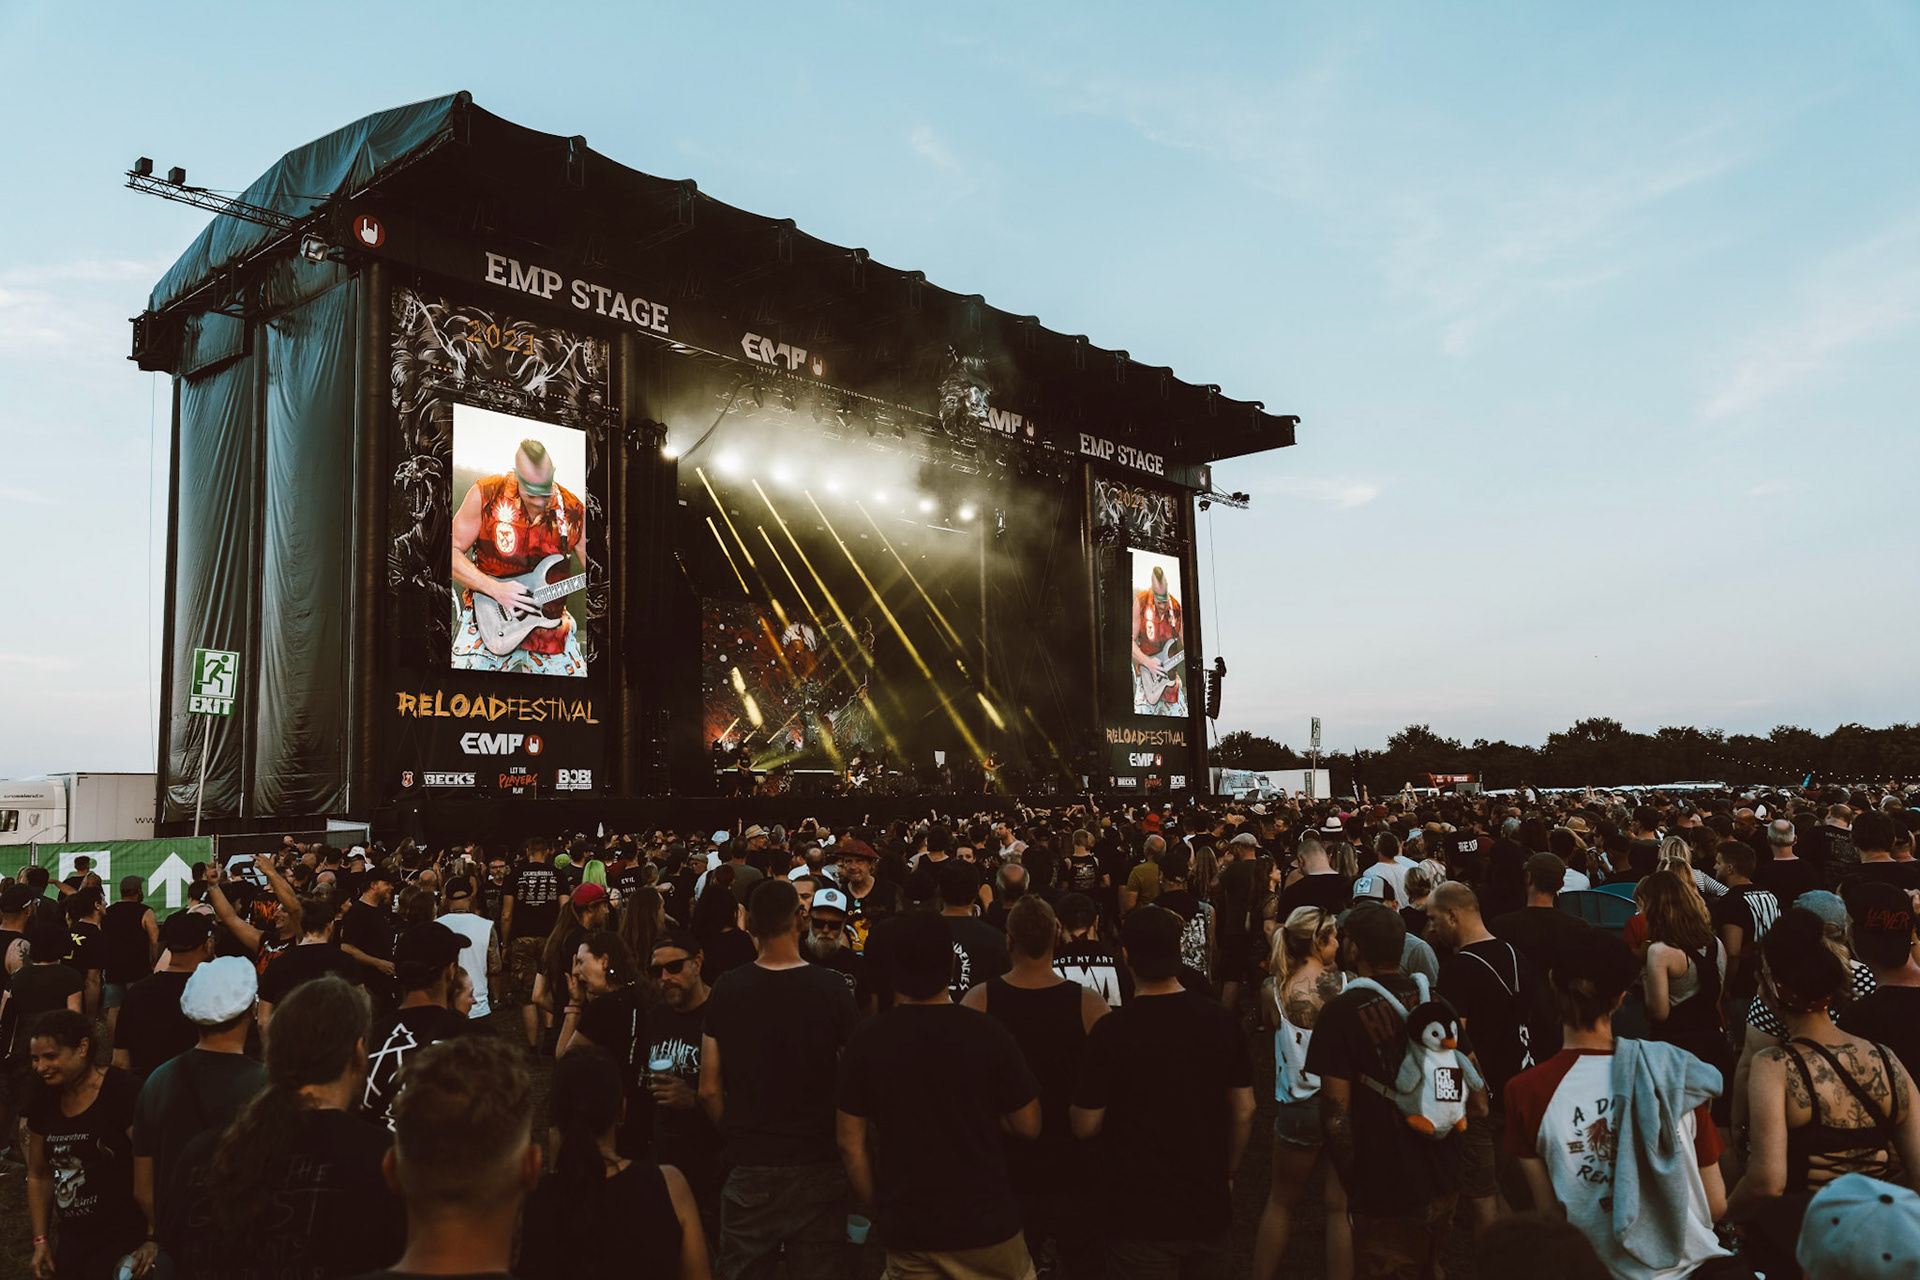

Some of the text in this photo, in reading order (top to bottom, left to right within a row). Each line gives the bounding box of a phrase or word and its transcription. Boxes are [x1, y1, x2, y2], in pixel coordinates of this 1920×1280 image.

[485, 251, 671, 334] EMP STAGE
[467, 320, 536, 356] 2023
[741, 332, 807, 371] EMP
[1079, 432, 1164, 477] EMP STAGE
[1116, 489, 1145, 510] 2023
[189, 696, 234, 715] EXIT
[460, 732, 524, 755] EMP
[1128, 752, 1155, 767] EMP
[499, 773, 539, 789] PLAYERS
[1053, 955, 1114, 965] NOT MY ART
[1436, 1069, 1451, 1080] ICH
[1437, 1079, 1455, 1090] HAB
[1573, 1106, 1585, 1127] A
